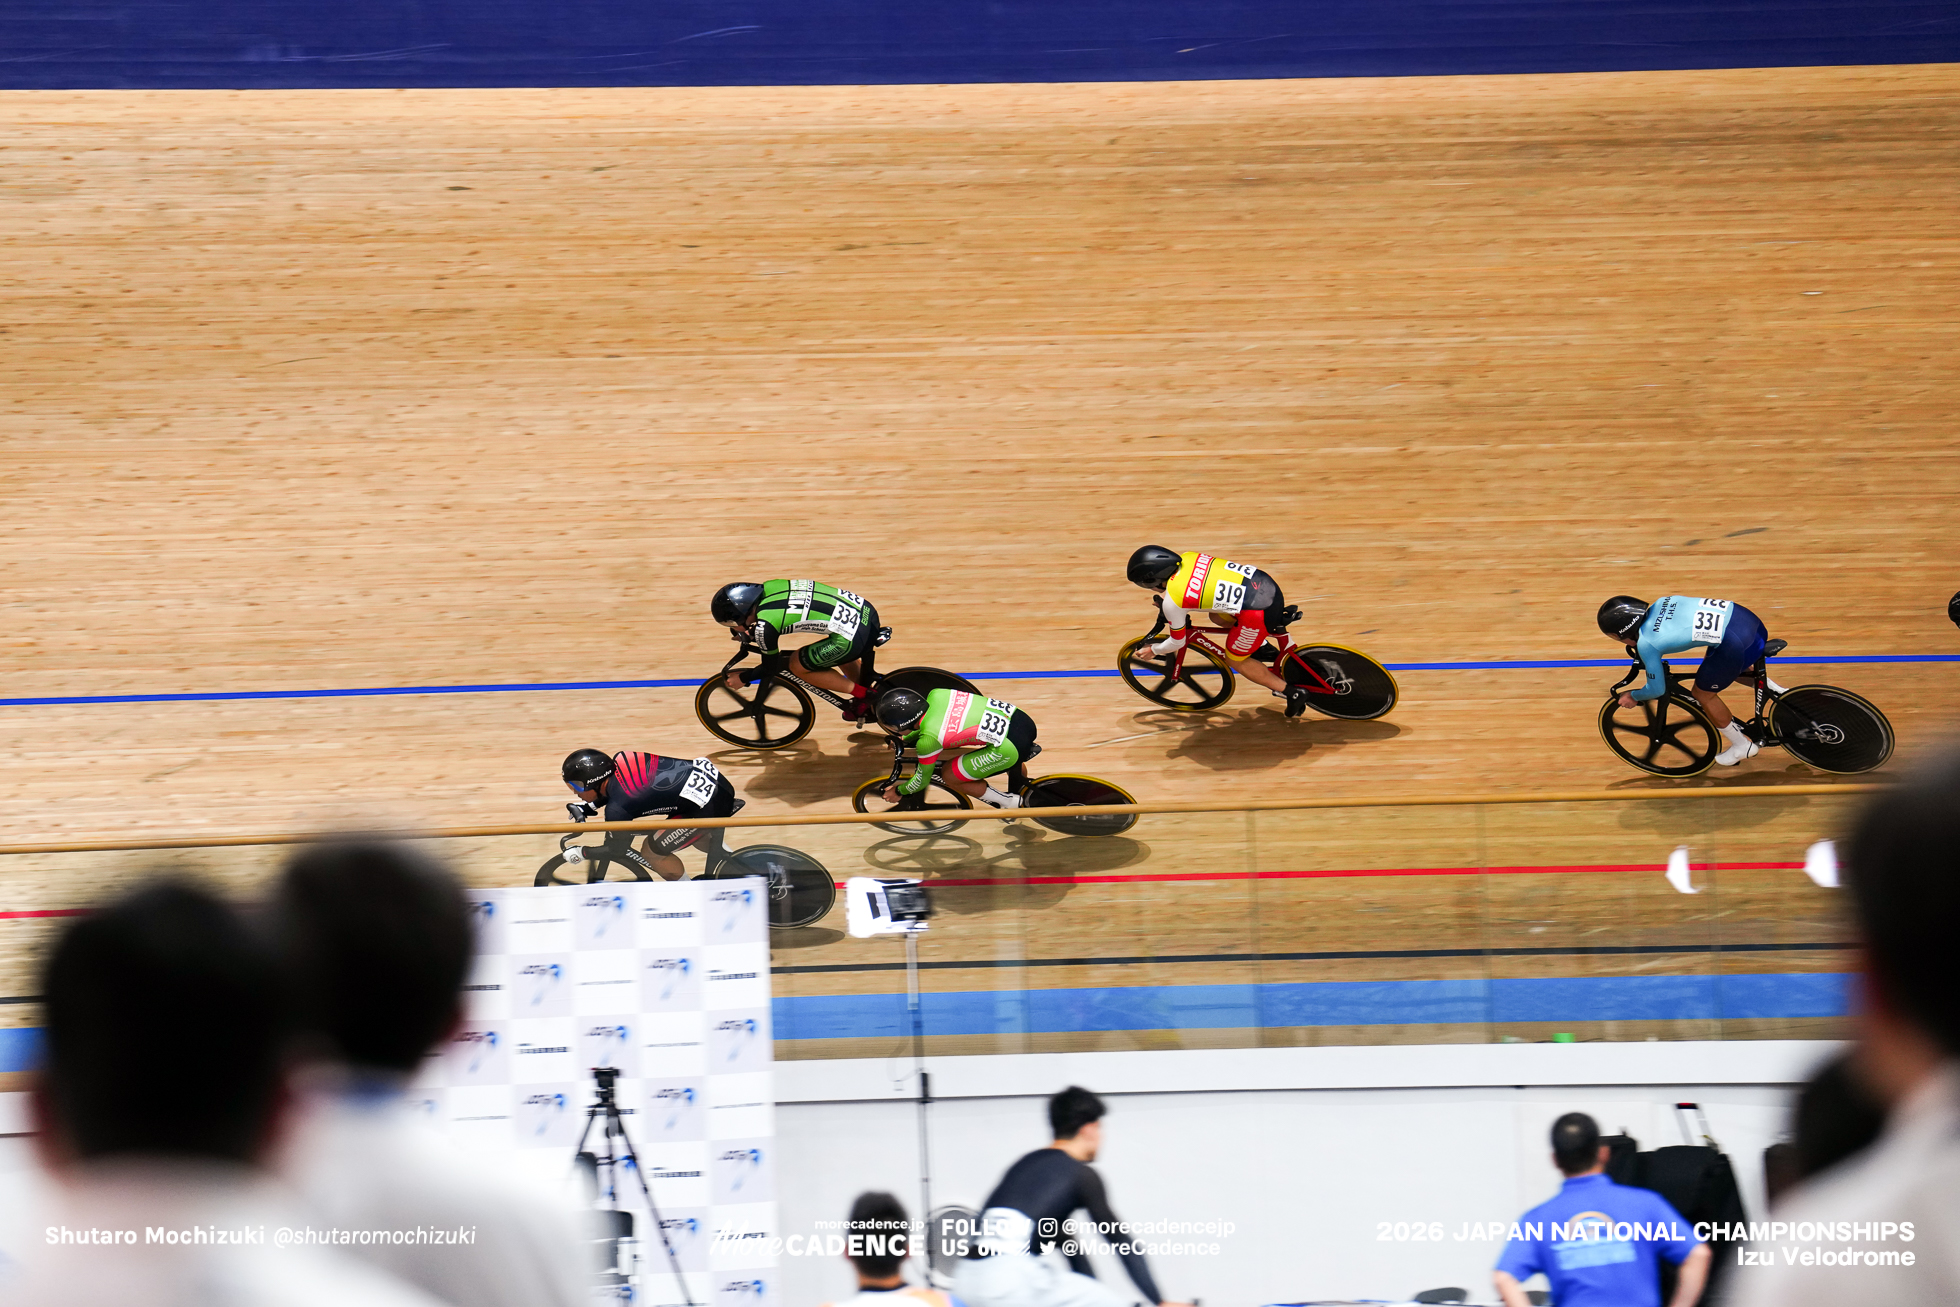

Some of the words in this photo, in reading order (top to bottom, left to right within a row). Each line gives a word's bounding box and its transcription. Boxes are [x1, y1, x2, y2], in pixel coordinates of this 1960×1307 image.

[1186, 553, 1212, 600] TORIDE
[1215, 583, 1243, 605] 319
[833, 604, 858, 629] 334
[1694, 611, 1721, 632] 331
[1231, 626, 1260, 653] TORIDE
[779, 669, 843, 707] BRIDGESTONE
[980, 713, 1007, 736] 333
[687, 773, 713, 798] 324
